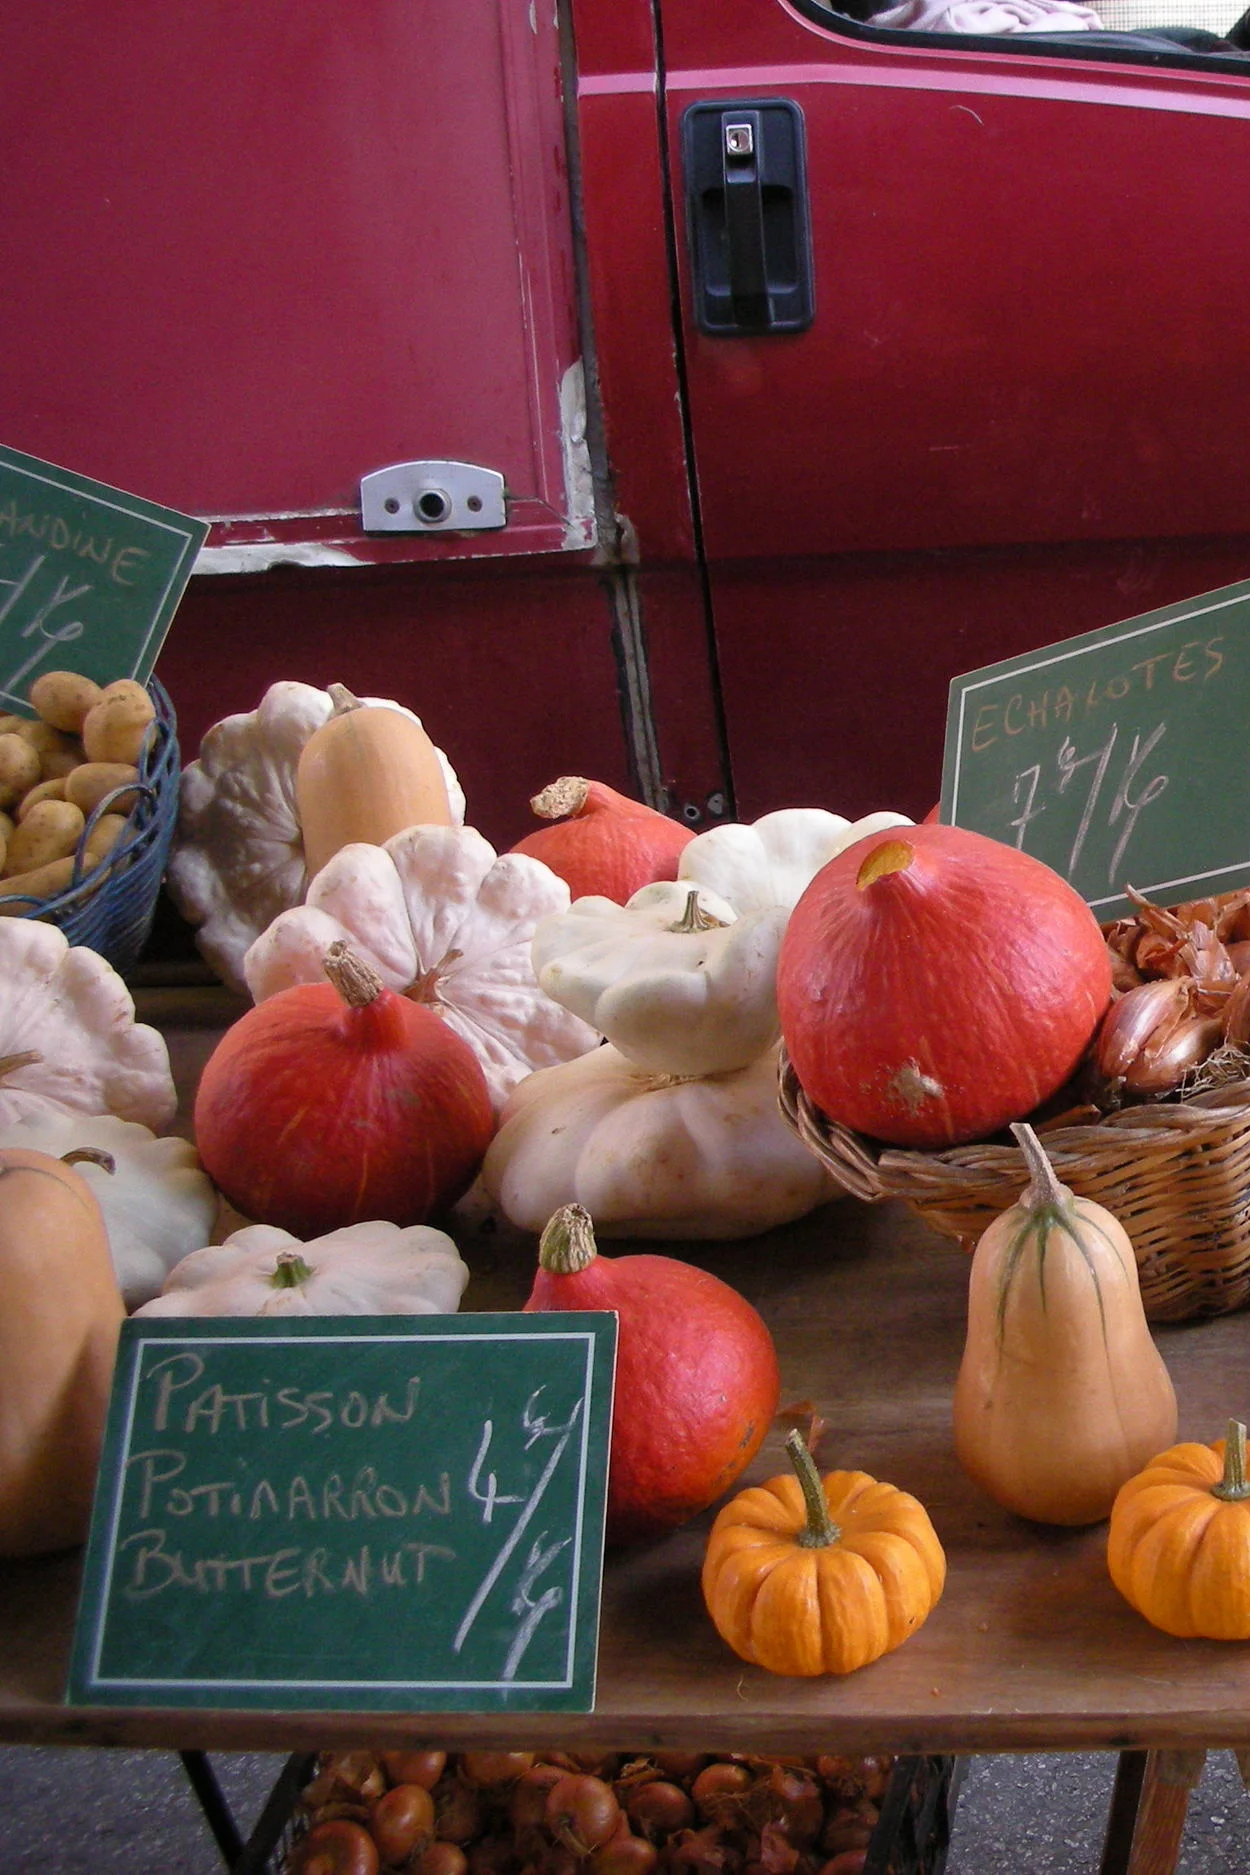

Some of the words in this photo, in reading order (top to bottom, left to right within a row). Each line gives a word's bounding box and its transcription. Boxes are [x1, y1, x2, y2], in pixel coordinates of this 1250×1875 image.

[971, 636, 1225, 753] ECHALOTES
[146, 1351, 421, 1434] PATISSON
[120, 1528, 456, 1599] BUTTERNUT
